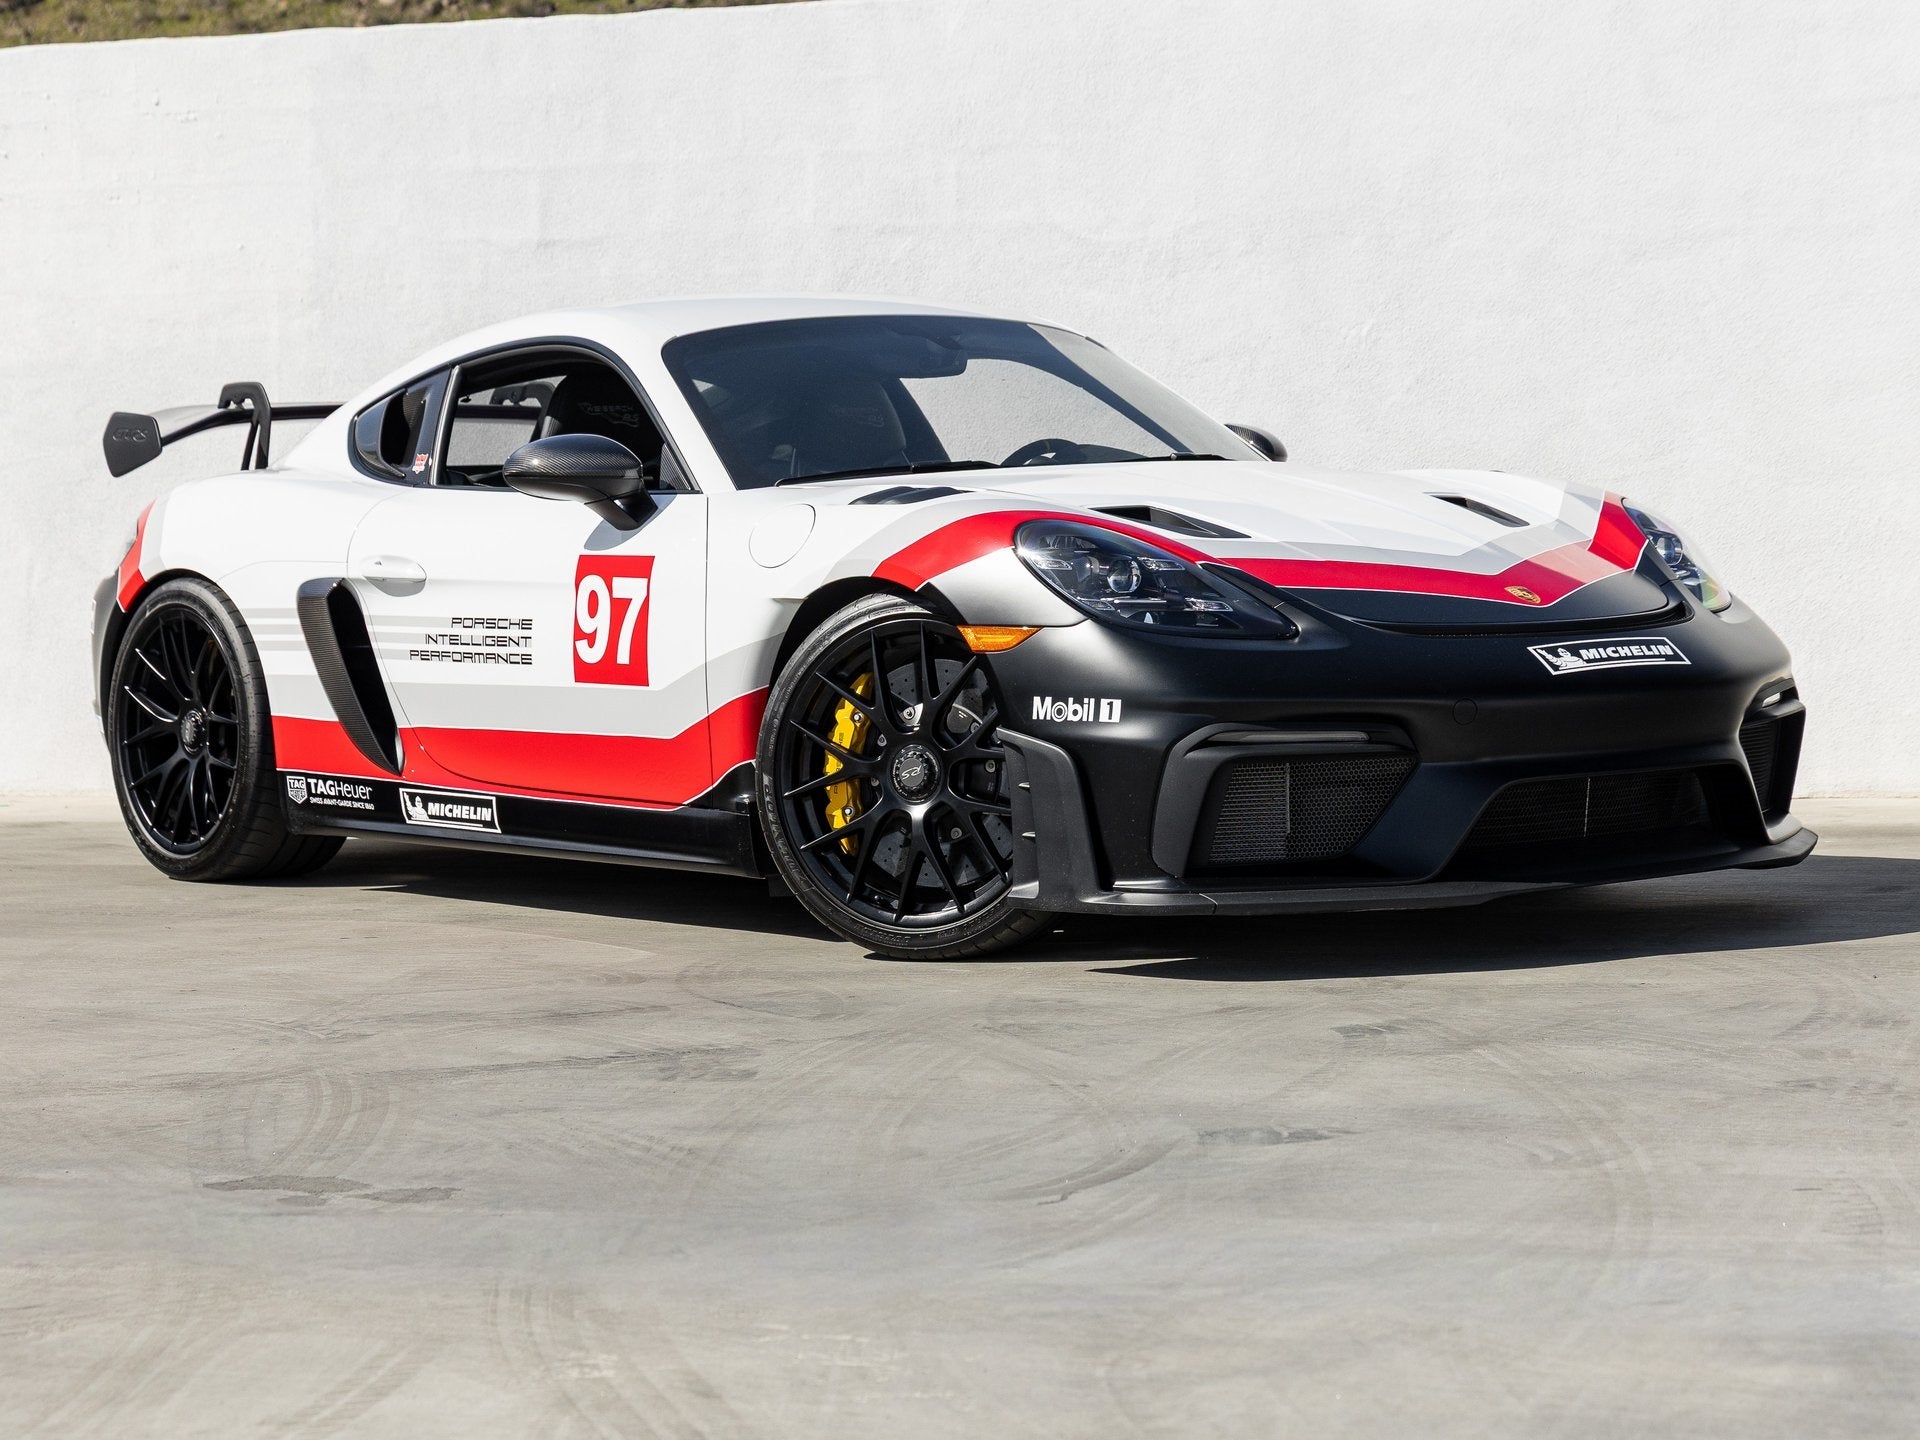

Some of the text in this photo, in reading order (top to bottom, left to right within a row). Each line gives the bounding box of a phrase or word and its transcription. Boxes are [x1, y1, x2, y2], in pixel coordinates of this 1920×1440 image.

[451, 617, 533, 630] PORSCHE
[575, 574, 648, 665] 97
[425, 633, 532, 647] INTELLIGENT
[409, 649, 533, 665] PERFORMANCE
[1579, 645, 1674, 660] MICHELIN
[1032, 696, 1095, 722] Mobil
[288, 779, 305, 789] TAG
[427, 802, 492, 821] MICHELIN
